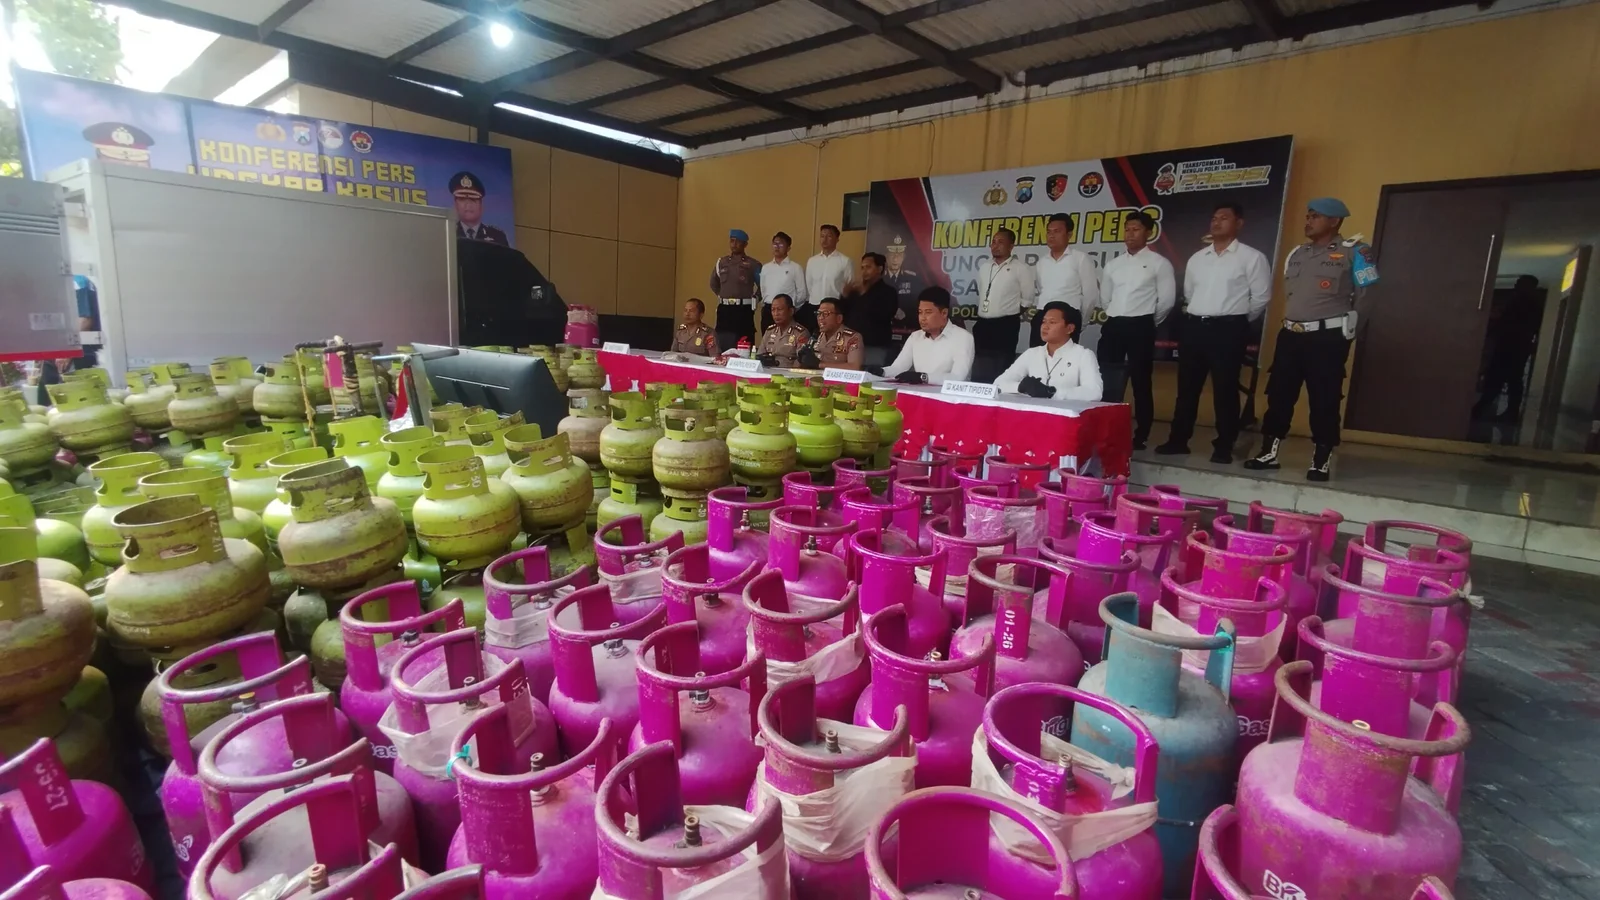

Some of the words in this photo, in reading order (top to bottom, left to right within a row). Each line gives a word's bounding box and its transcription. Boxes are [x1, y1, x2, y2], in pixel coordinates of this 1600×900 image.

[200, 139, 355, 177] KONFERENSI
[362, 160, 416, 184] PERS
[1182, 160, 1223, 168] TRANSFORMASI
[932, 212, 1080, 249] KONFERENI
[952, 384, 968, 392] KANIT
[1002, 609, 1016, 650] 01-26
[371, 741, 398, 758] as
